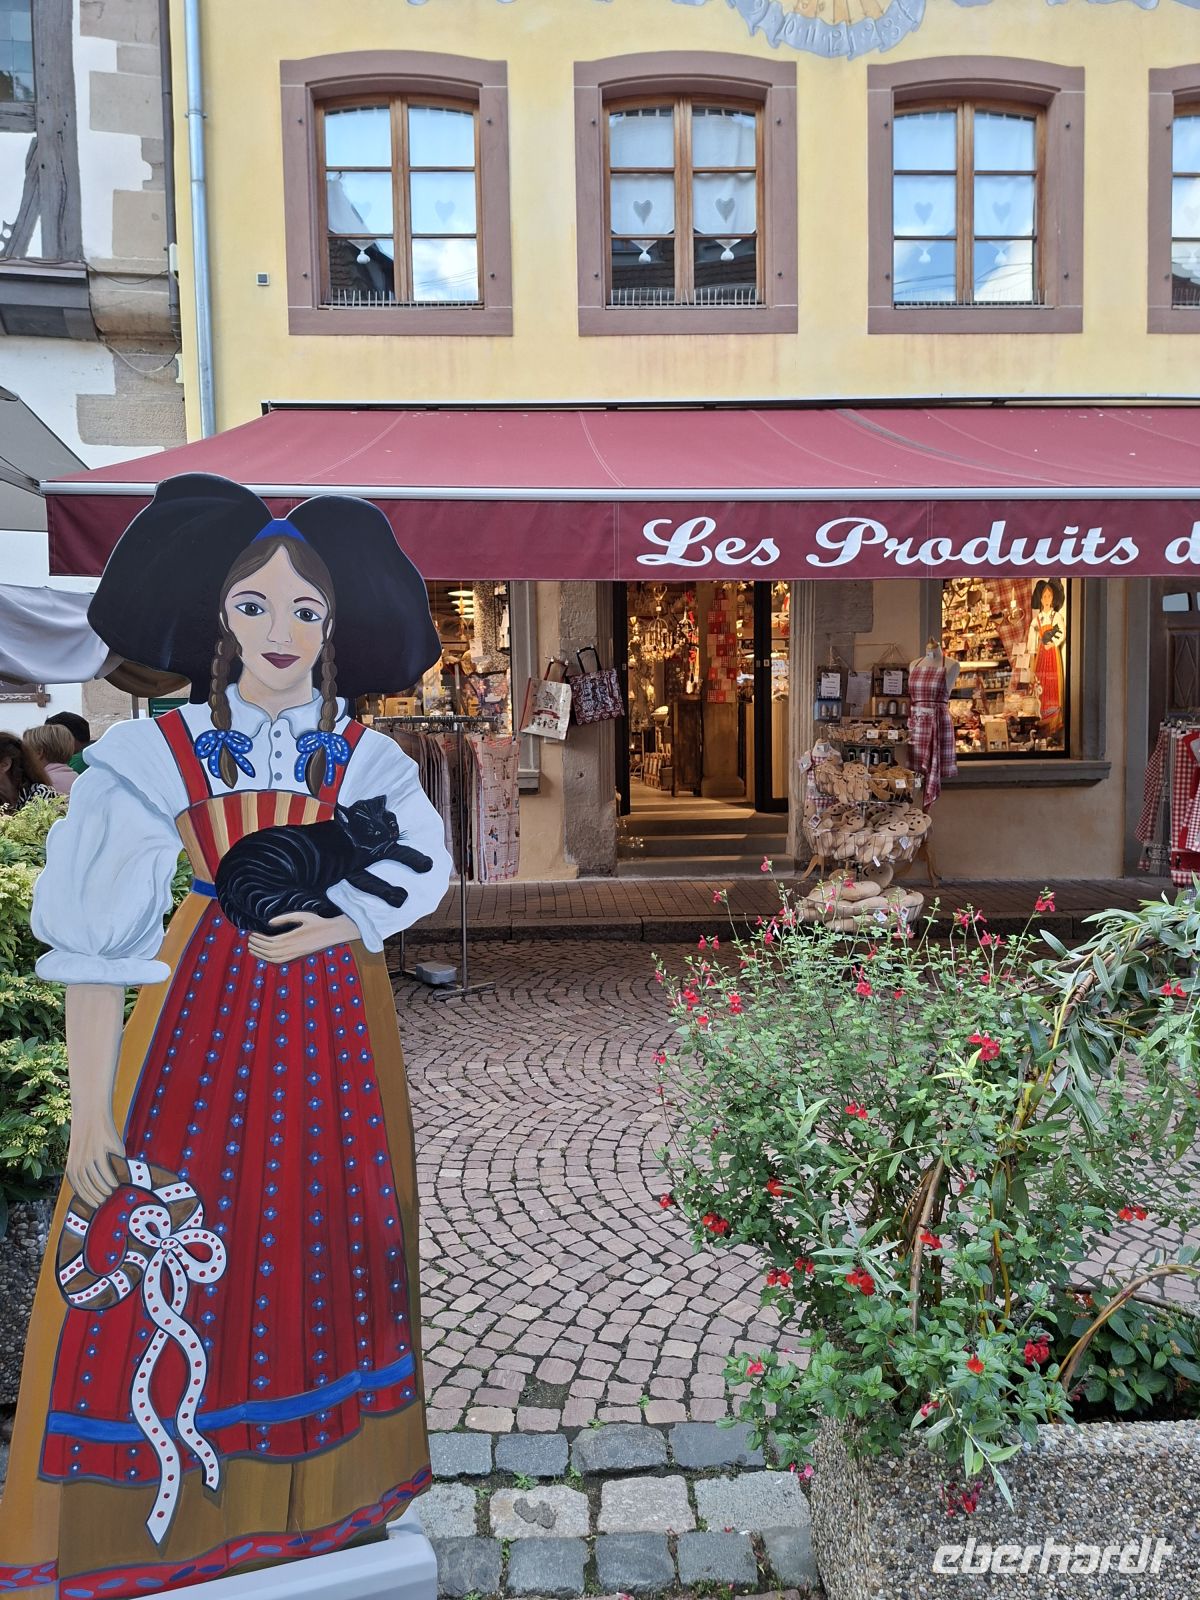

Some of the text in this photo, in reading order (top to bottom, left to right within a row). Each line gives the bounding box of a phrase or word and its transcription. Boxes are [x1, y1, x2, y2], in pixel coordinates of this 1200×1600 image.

[827, 29, 843, 54] 12
[636, 516, 781, 567] Les
[805, 517, 1140, 567] Produits
